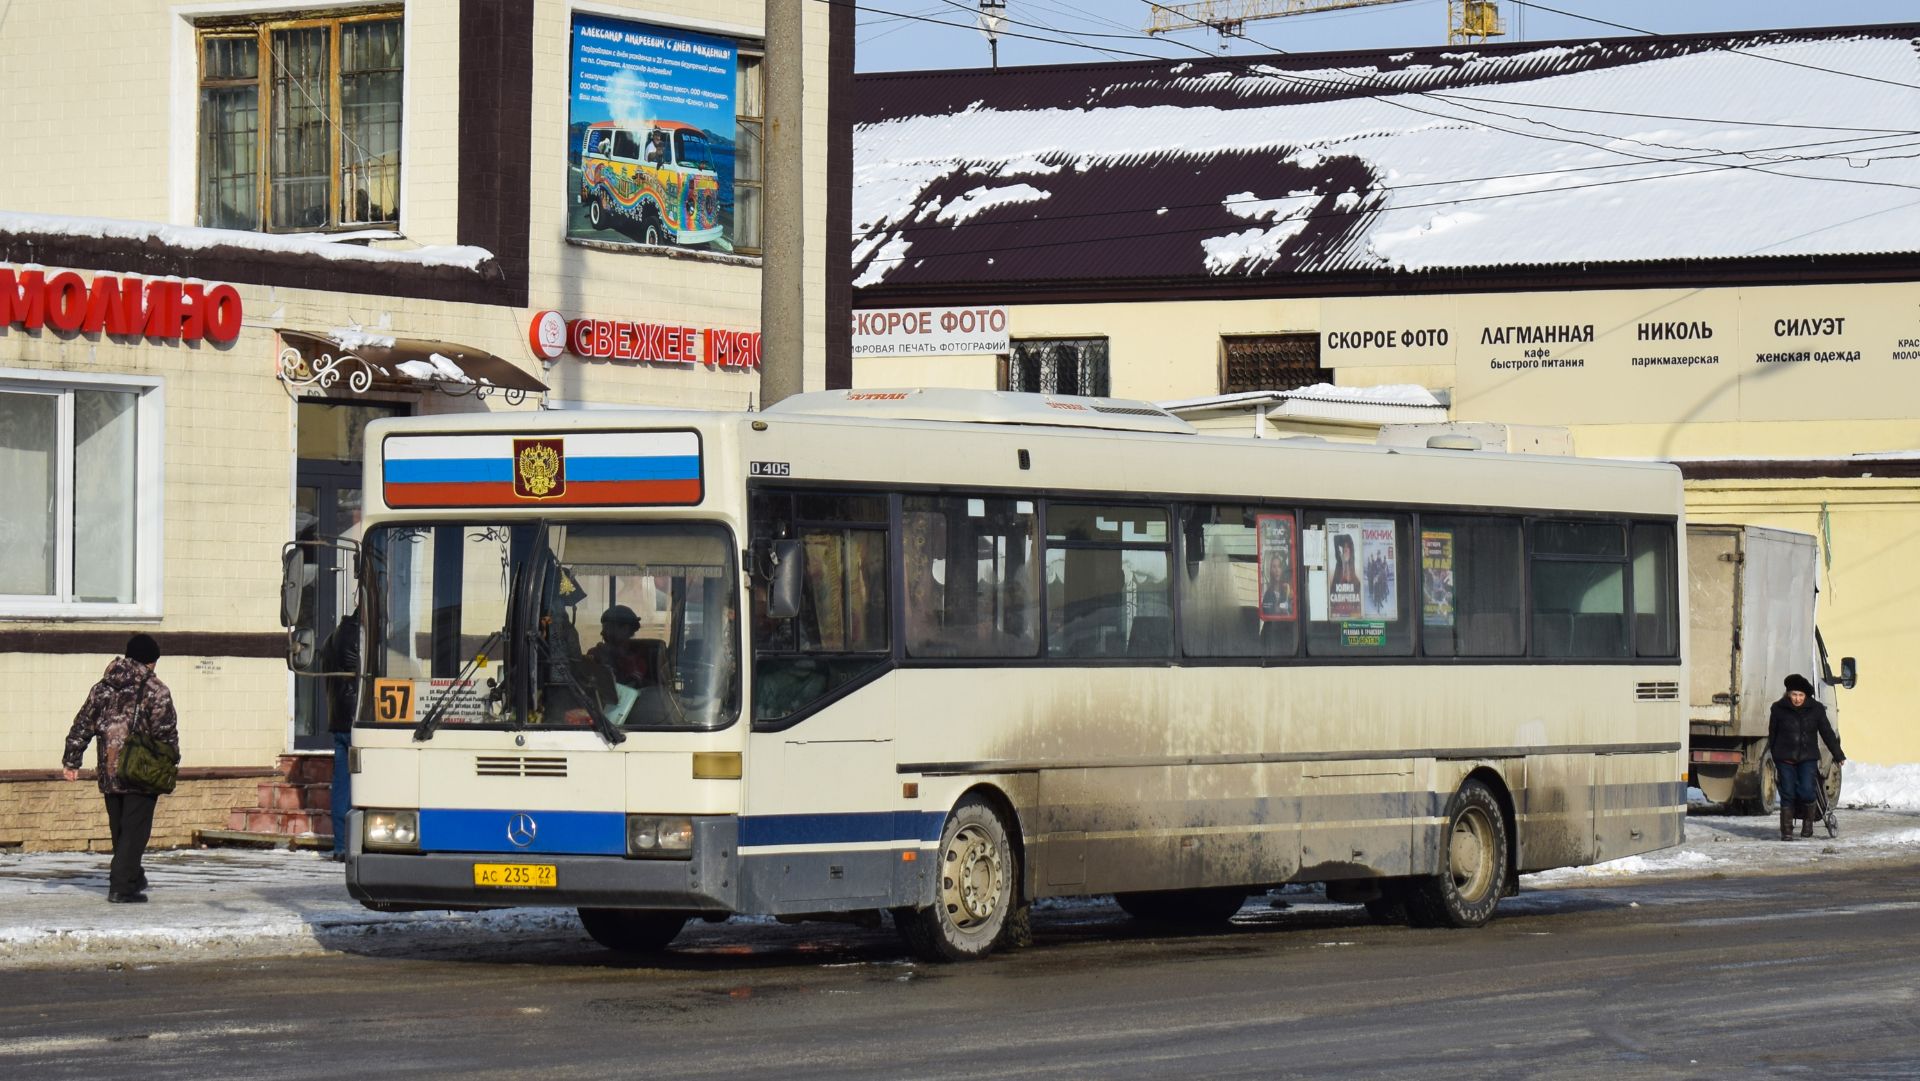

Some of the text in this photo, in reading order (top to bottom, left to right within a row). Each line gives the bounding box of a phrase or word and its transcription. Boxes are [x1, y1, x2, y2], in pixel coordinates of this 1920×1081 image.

[581, 26, 623, 42] АЛЕКСАНДР
[667, 40, 672, 49] С
[692, 44, 730, 60] РОЖДЕНИЯ!
[940, 309, 1006, 333] ФОТО
[1774, 318, 1845, 337] СИЛУЭТ
[1327, 328, 1449, 349] СКОРОЕ ФОТО
[1480, 325, 1594, 345] ЛАГМАННАЯ
[1637, 321, 1713, 341] НИКОЛЬ
[568, 319, 697, 363] СВЕЖЕЕ
[898, 343, 936, 353] ПЕЧАТЬ
[940, 340, 1006, 352] ФОТОГРАФИЙ
[1524, 348, 1550, 360] кафе
[1631, 353, 1719, 367] парикмахерская
[1756, 350, 1861, 364] женская одежда
[1490, 358, 1584, 371] быстрого питания
[763, 463, 789, 475] 405
[1362, 529, 1393, 540] ПИКНИК
[1336, 583, 1354, 593] ЮЛИЯ
[1330, 593, 1360, 603] САВИЧЕВА
[380, 685, 411, 720] 57
[482, 867, 551, 883] АС 235 22
